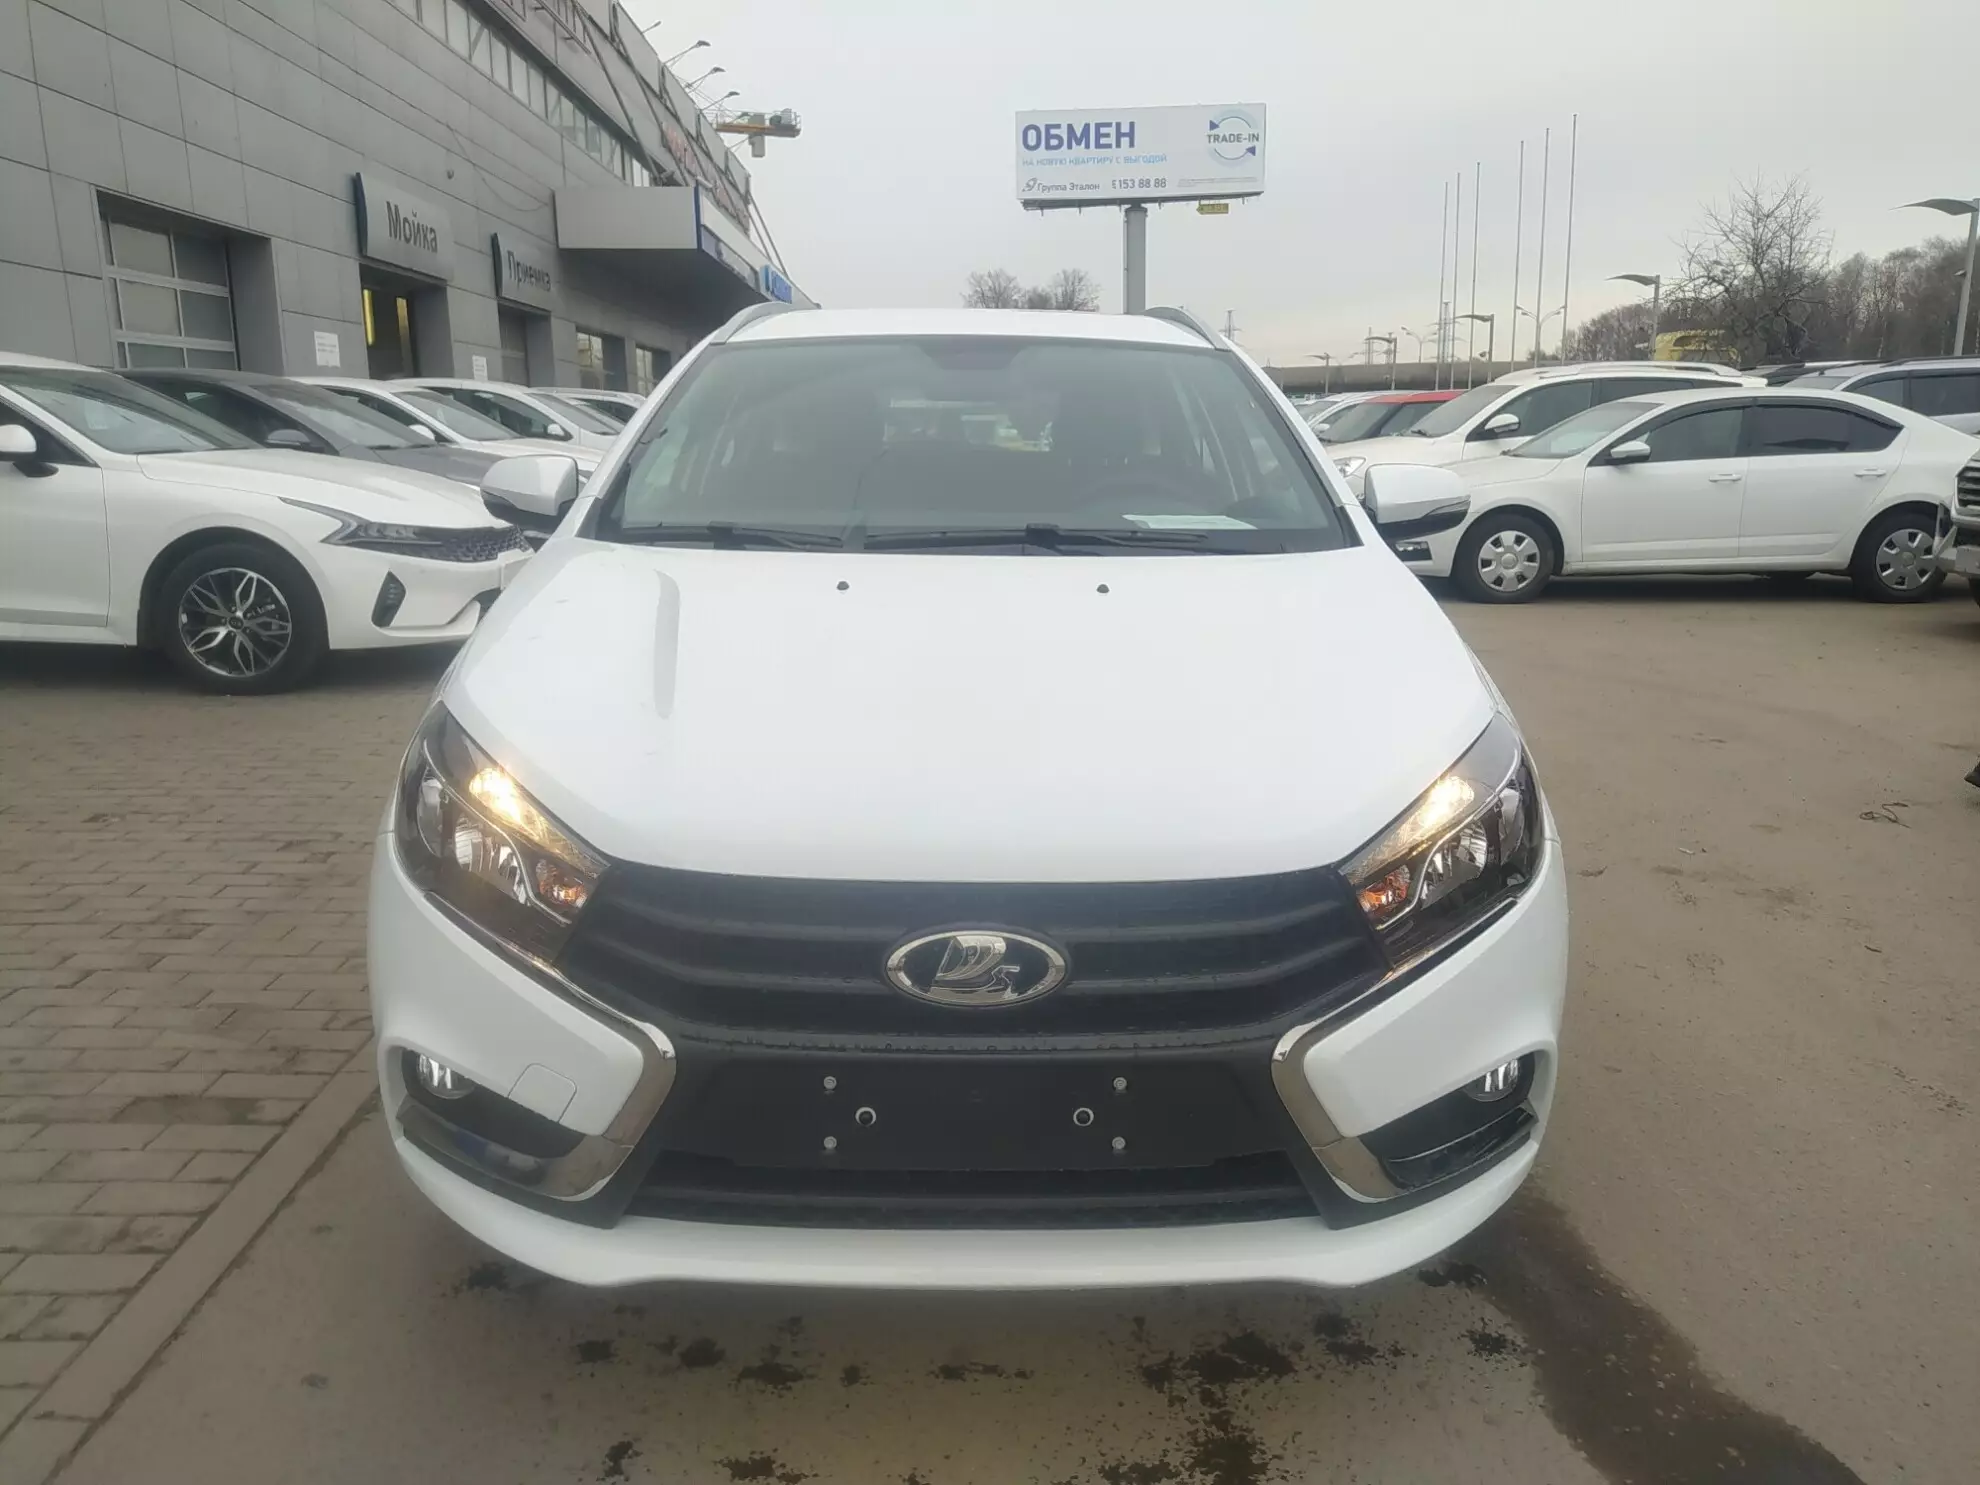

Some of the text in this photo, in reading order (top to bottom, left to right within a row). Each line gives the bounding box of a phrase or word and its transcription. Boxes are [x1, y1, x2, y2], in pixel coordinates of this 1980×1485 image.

[1022, 121, 1135, 151] ОБМЕН
[1207, 133, 1260, 144] TRADE-IN
[1069, 156, 1113, 165] КВАРТИРУ
[1123, 153, 1168, 164] ВЫГОДОЙ
[1037, 182, 1067, 193] Группа
[1069, 182, 1100, 191] Эталон
[1118, 178, 1135, 190] 153
[1138, 178, 1151, 189] 88
[1154, 177, 1167, 188] 88
[386, 200, 438, 253] Мойка
[507, 250, 551, 292] Приемка
